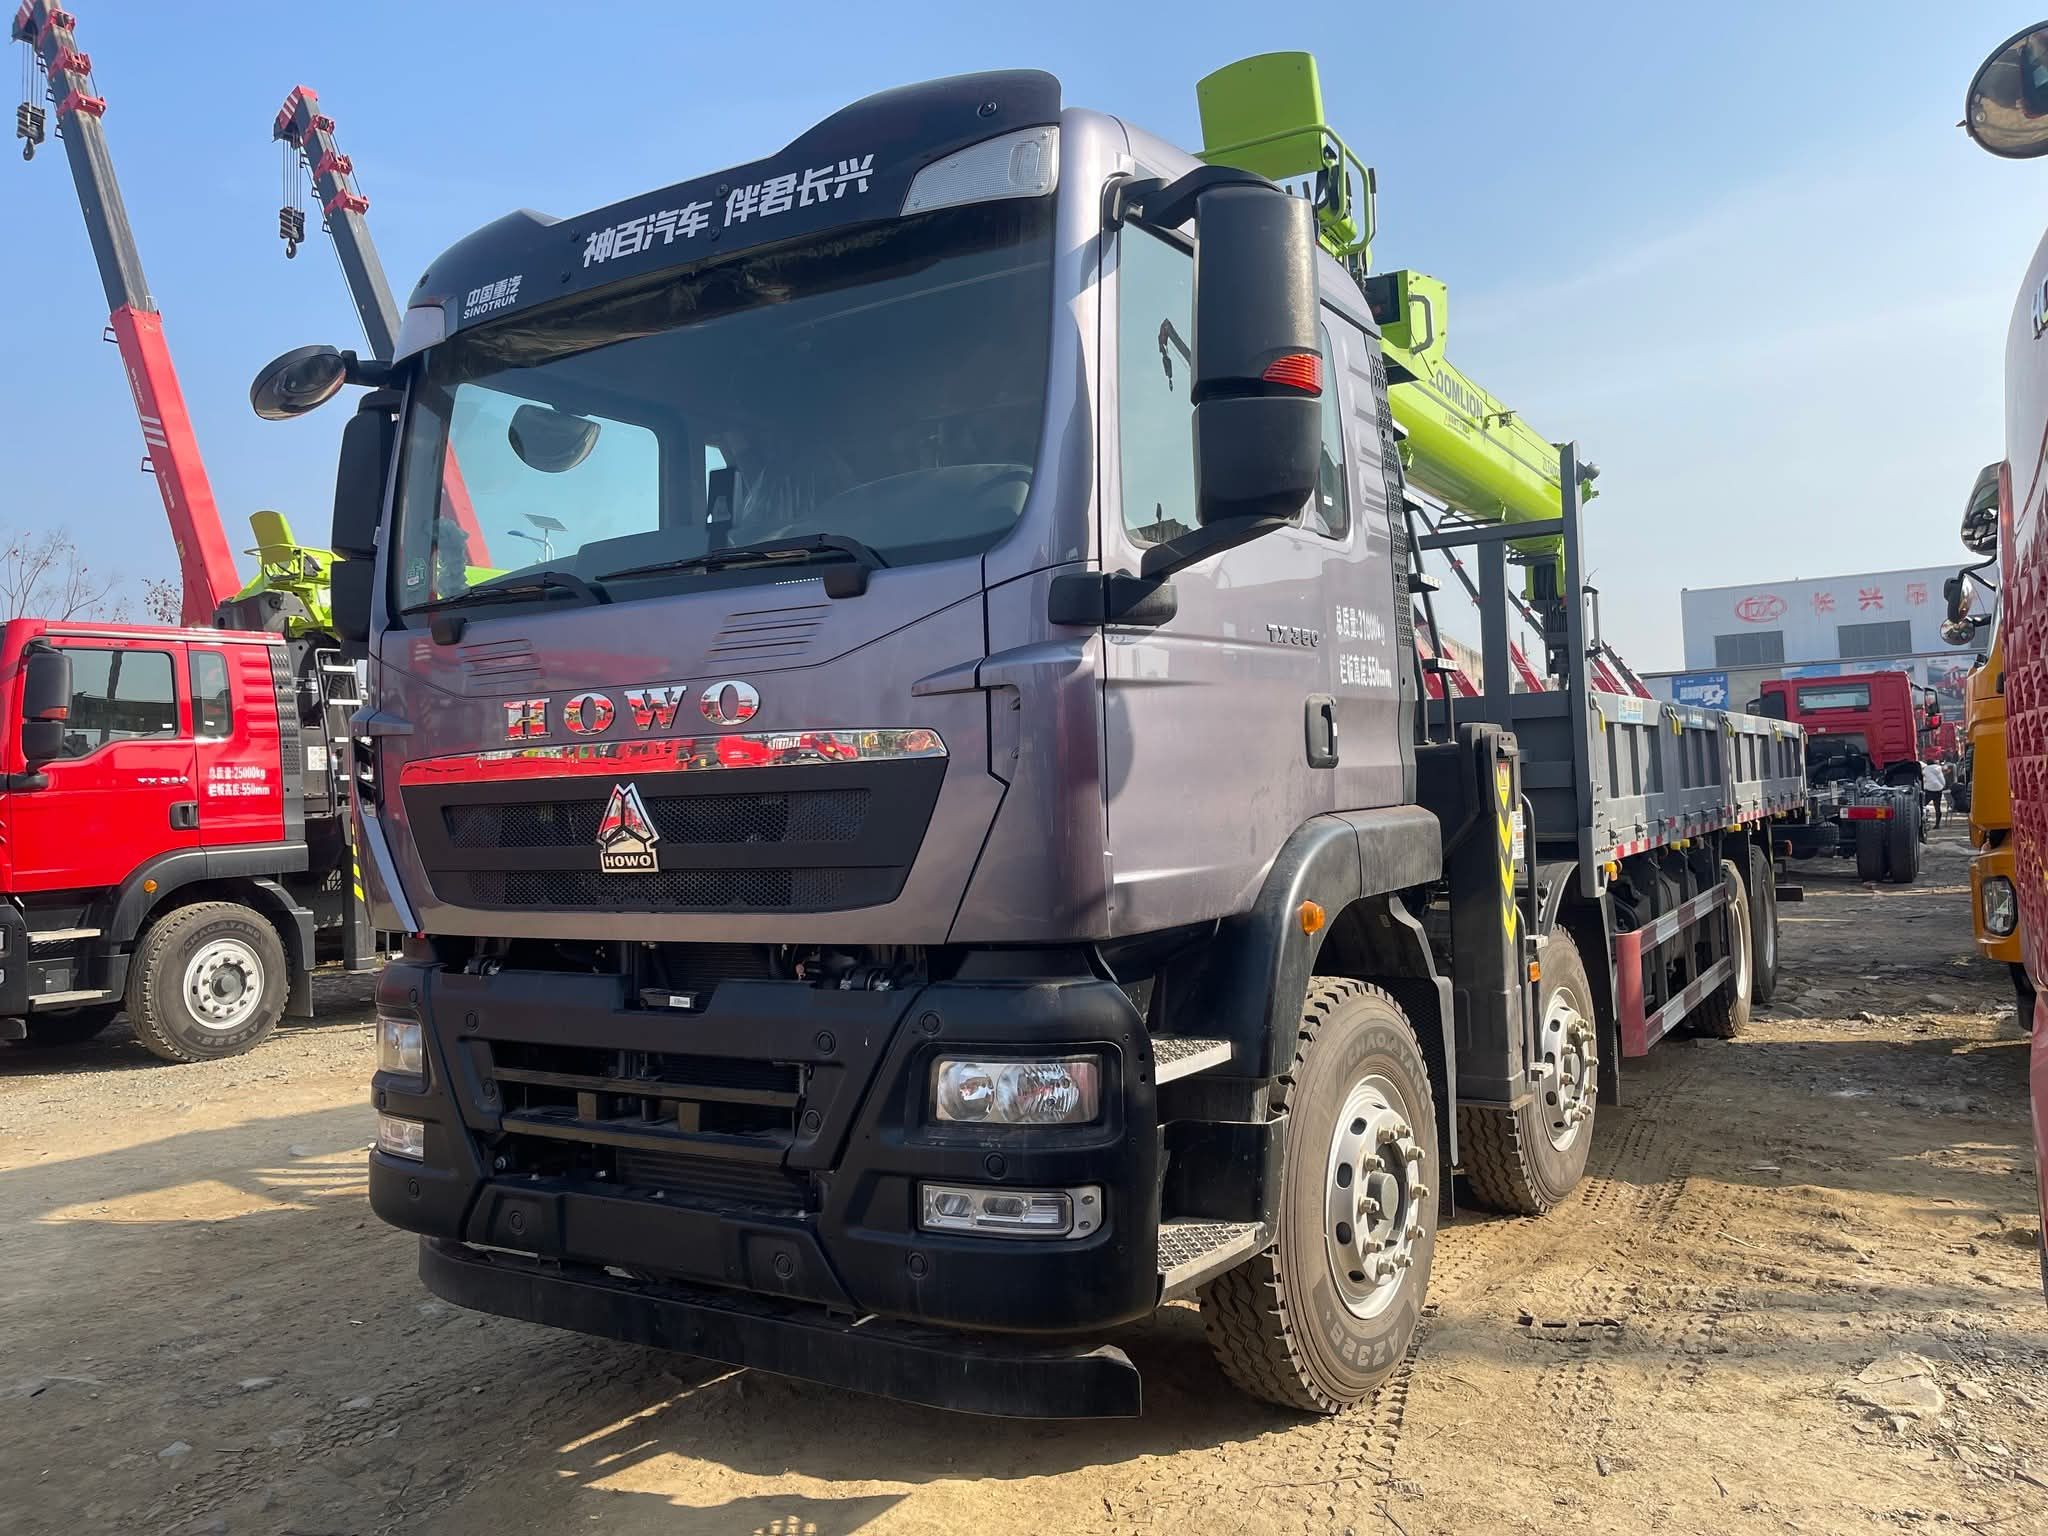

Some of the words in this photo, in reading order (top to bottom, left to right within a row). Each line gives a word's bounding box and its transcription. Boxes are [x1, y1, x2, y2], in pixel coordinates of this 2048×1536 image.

[583, 201, 713, 268] 神百汽车
[724, 154, 874, 227] 伴君长兴
[463, 293, 517, 319] SINOTRUK
[466, 275, 522, 307] 中国重汽
[1428, 369, 1483, 422] OOMLION
[503, 680, 760, 741] HOWO
[604, 855, 651, 868] HOWO
